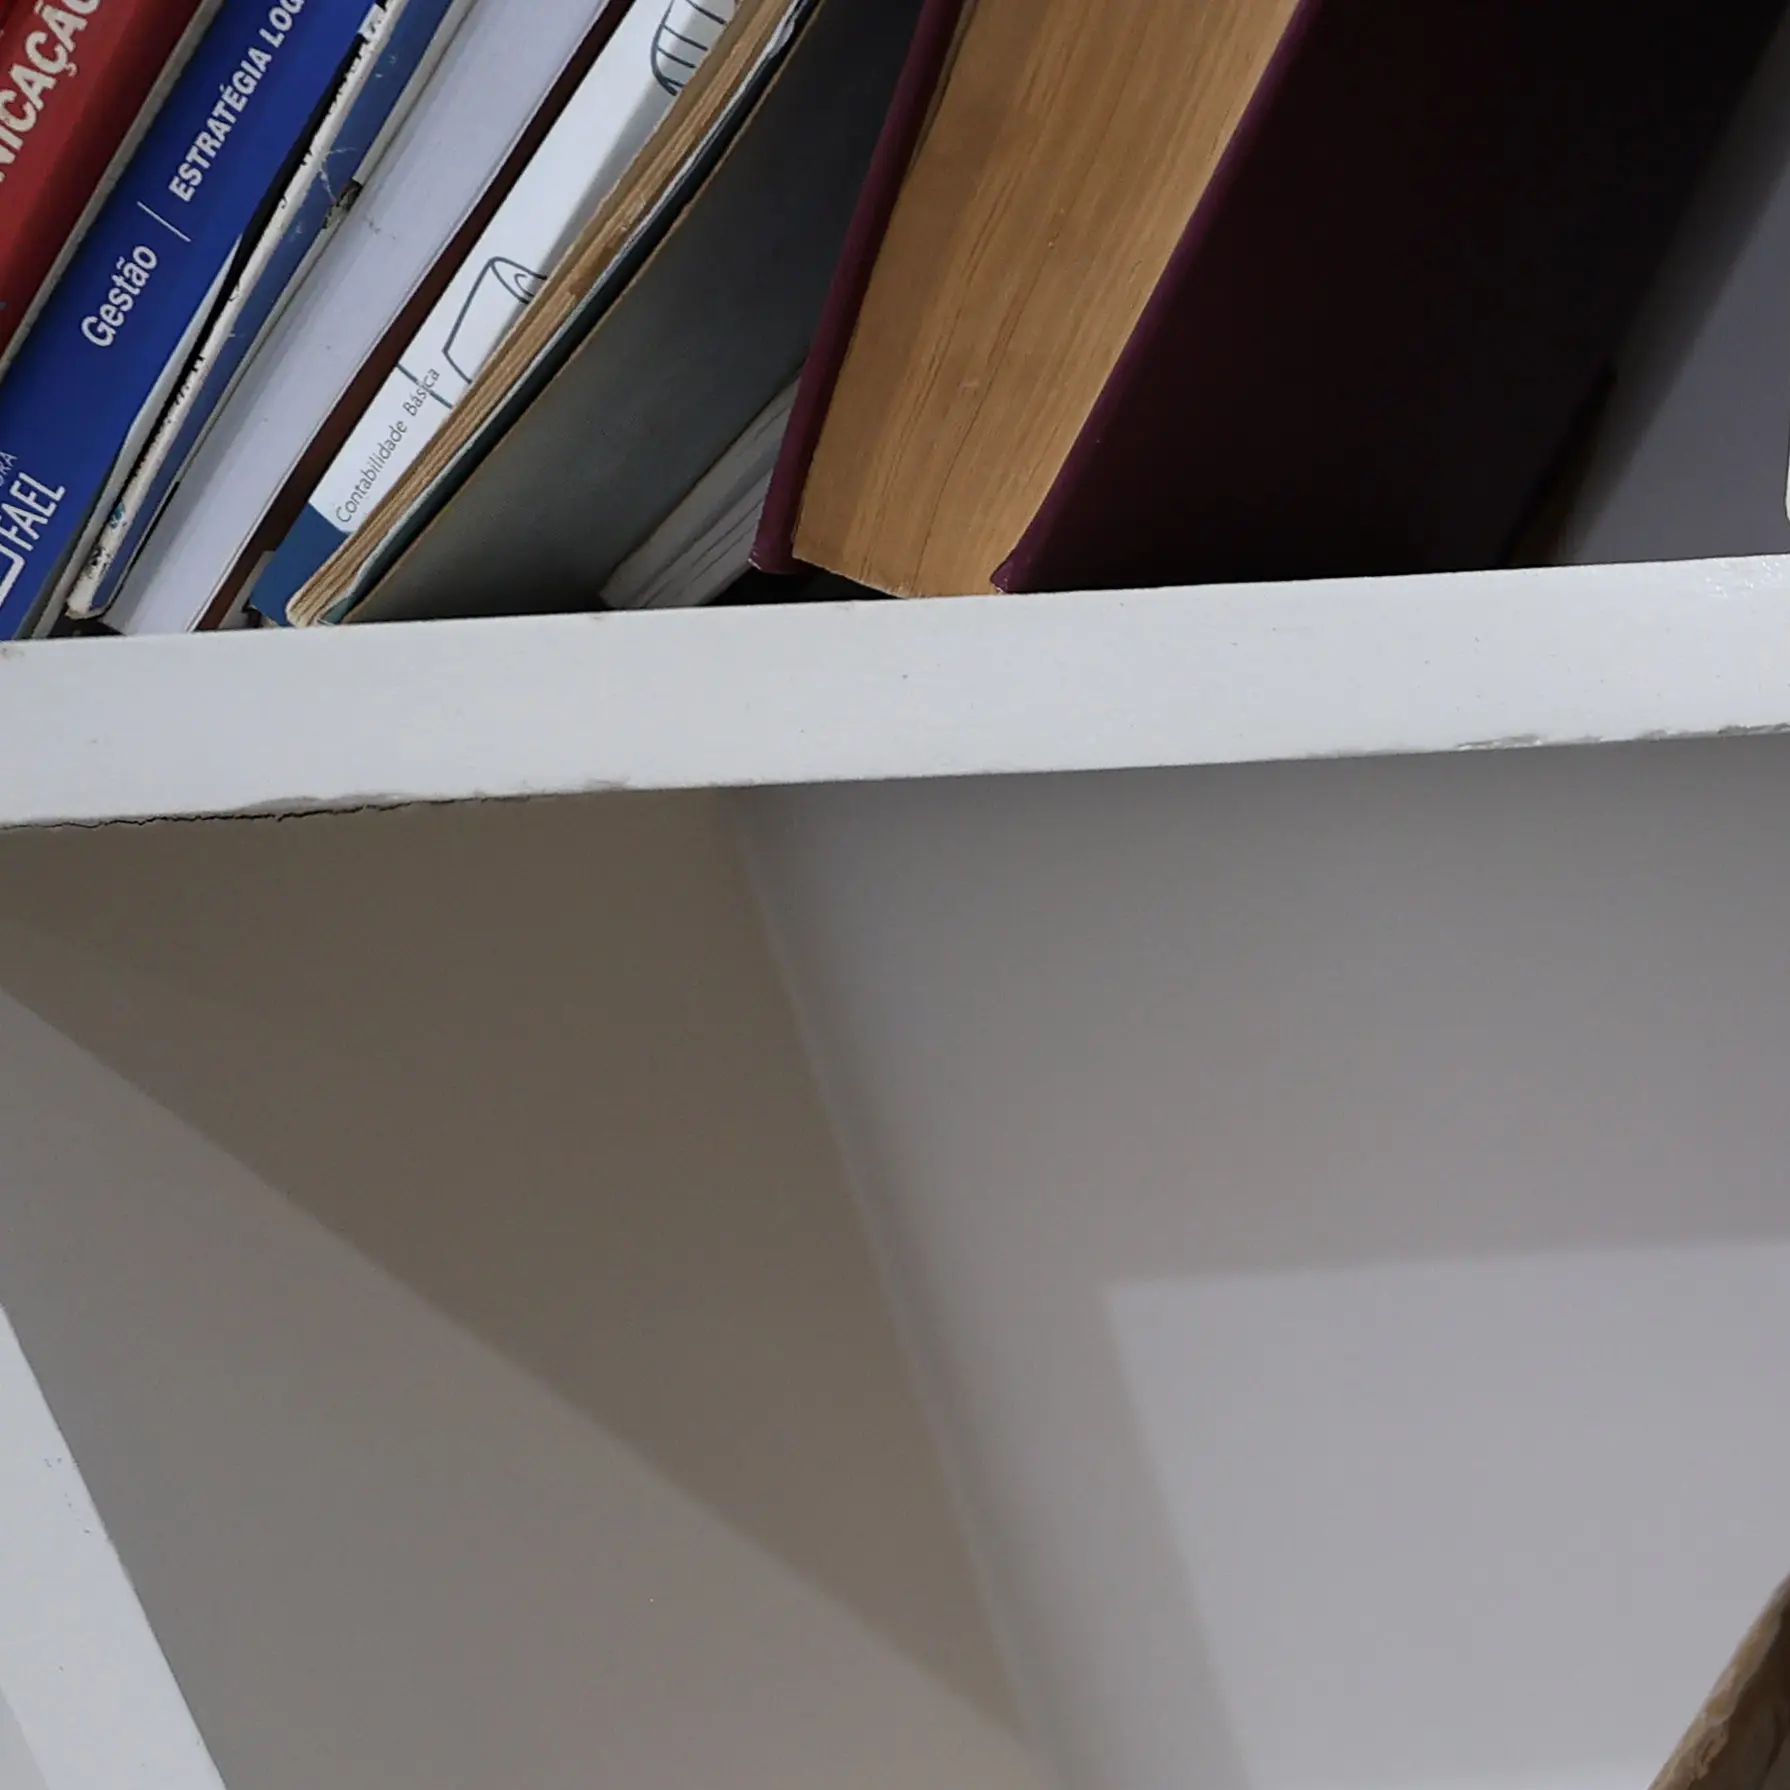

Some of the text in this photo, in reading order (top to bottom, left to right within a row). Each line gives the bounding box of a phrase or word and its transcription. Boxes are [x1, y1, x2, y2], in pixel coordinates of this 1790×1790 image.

[81, 245, 157, 346] Gestão
[168, 47, 272, 202] ESTRATÉGIA
[336, 368, 440, 523] Contabilidade Básica
